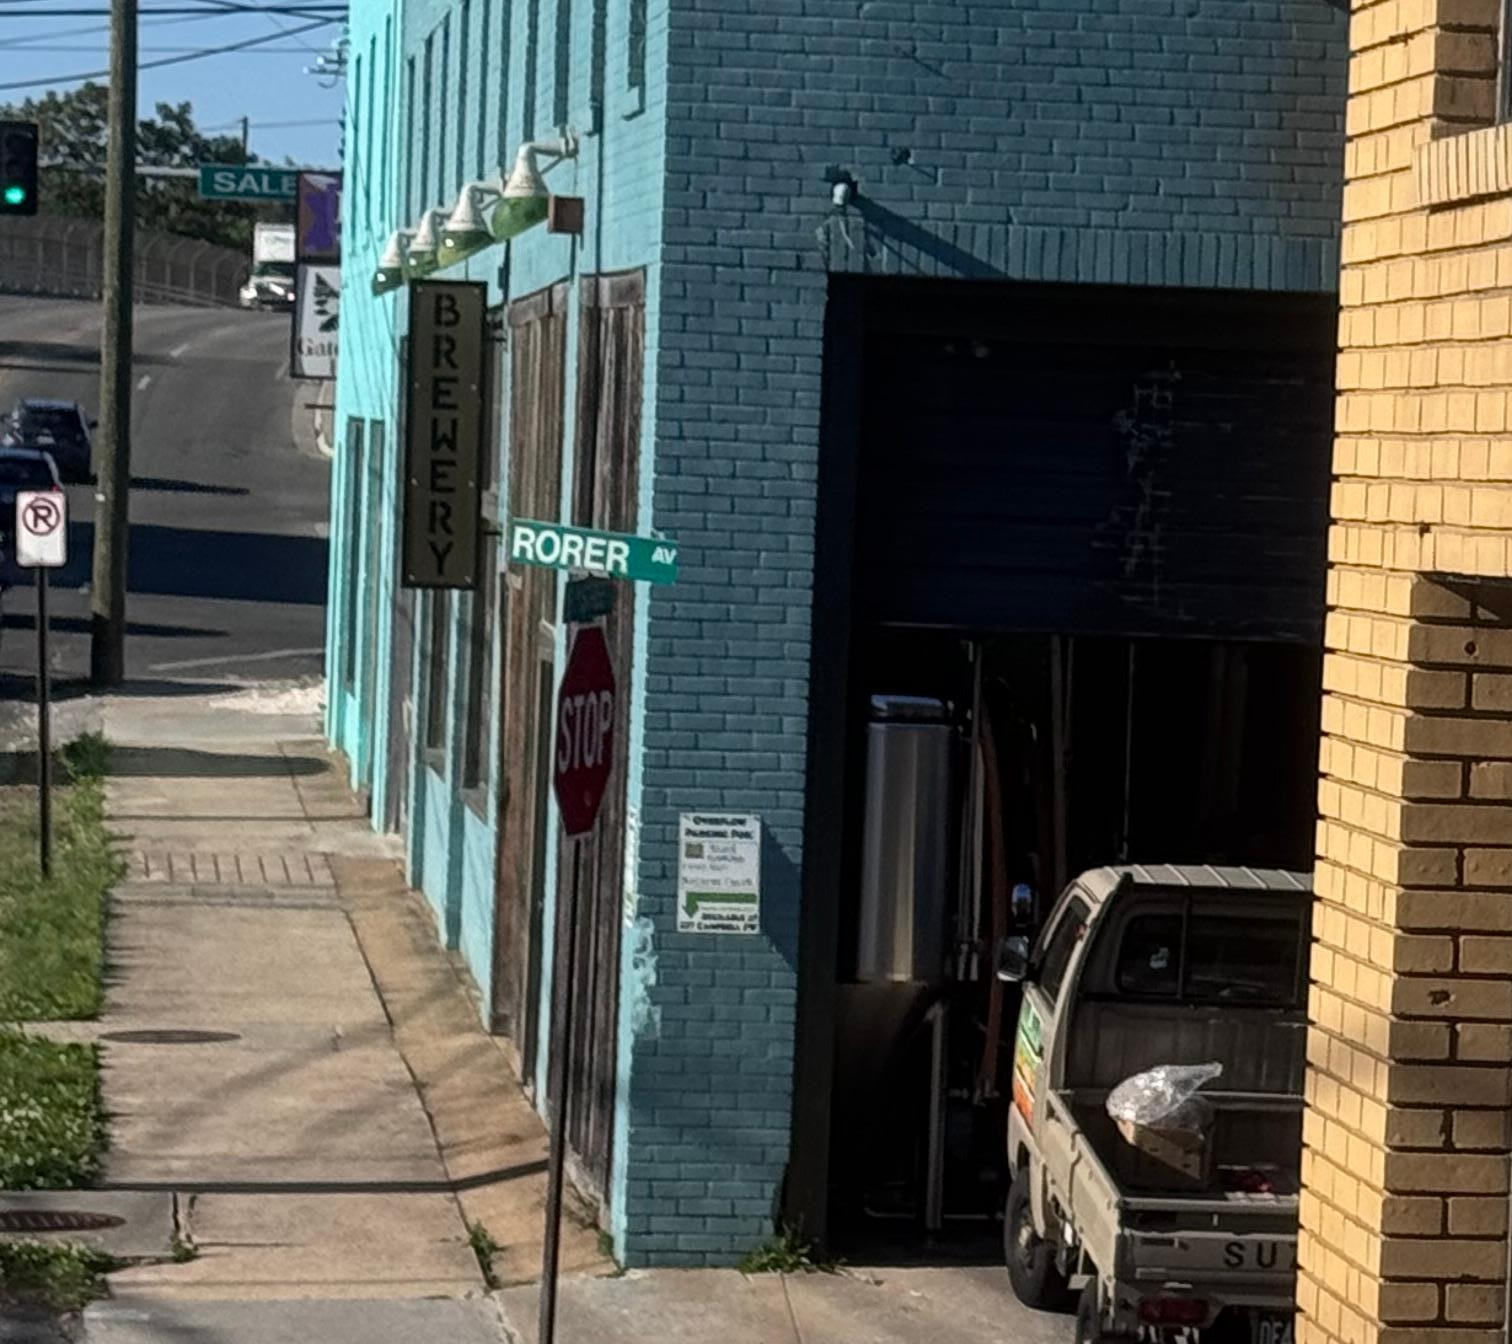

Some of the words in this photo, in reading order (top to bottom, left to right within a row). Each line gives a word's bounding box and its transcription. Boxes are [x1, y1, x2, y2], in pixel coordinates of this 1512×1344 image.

[428, 293, 461, 576] BREWERY
[512, 525, 631, 574] RORER
[651, 546, 678, 565] AV
[558, 689, 614, 774] STOP
[1223, 1241, 1297, 1269] SU
